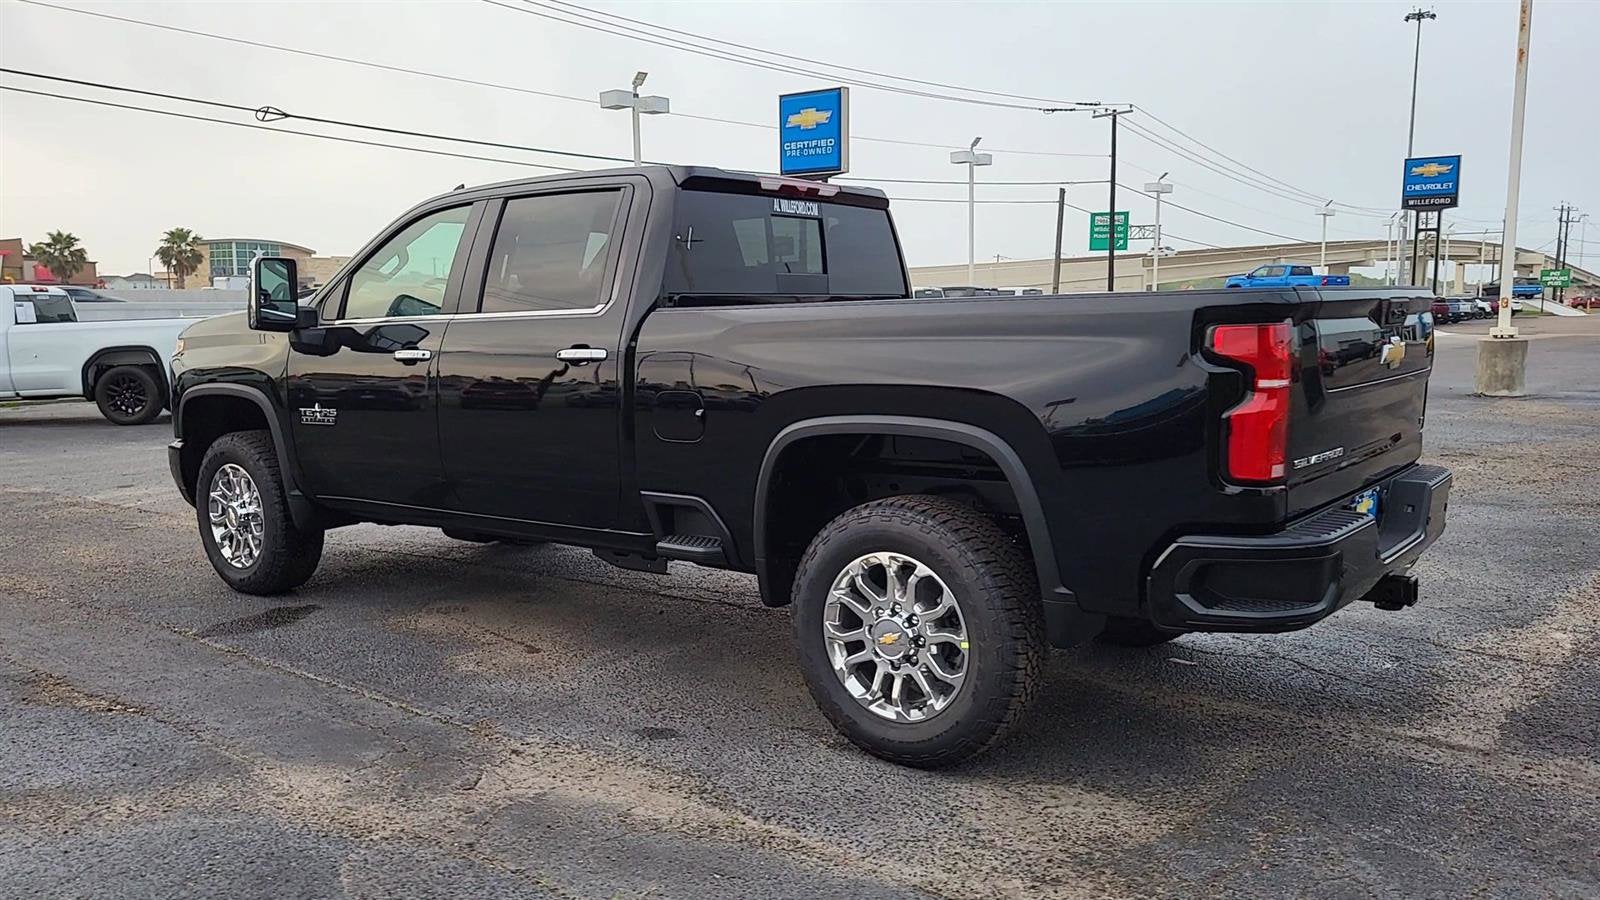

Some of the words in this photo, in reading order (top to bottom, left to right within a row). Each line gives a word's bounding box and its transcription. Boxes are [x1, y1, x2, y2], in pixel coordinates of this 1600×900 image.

[784, 139, 835, 151] CERTIFIED
[786, 146, 833, 157] PRE-OWNED
[1406, 182, 1454, 191] CHEVROLET
[1408, 197, 1451, 206] WILLEFORD
